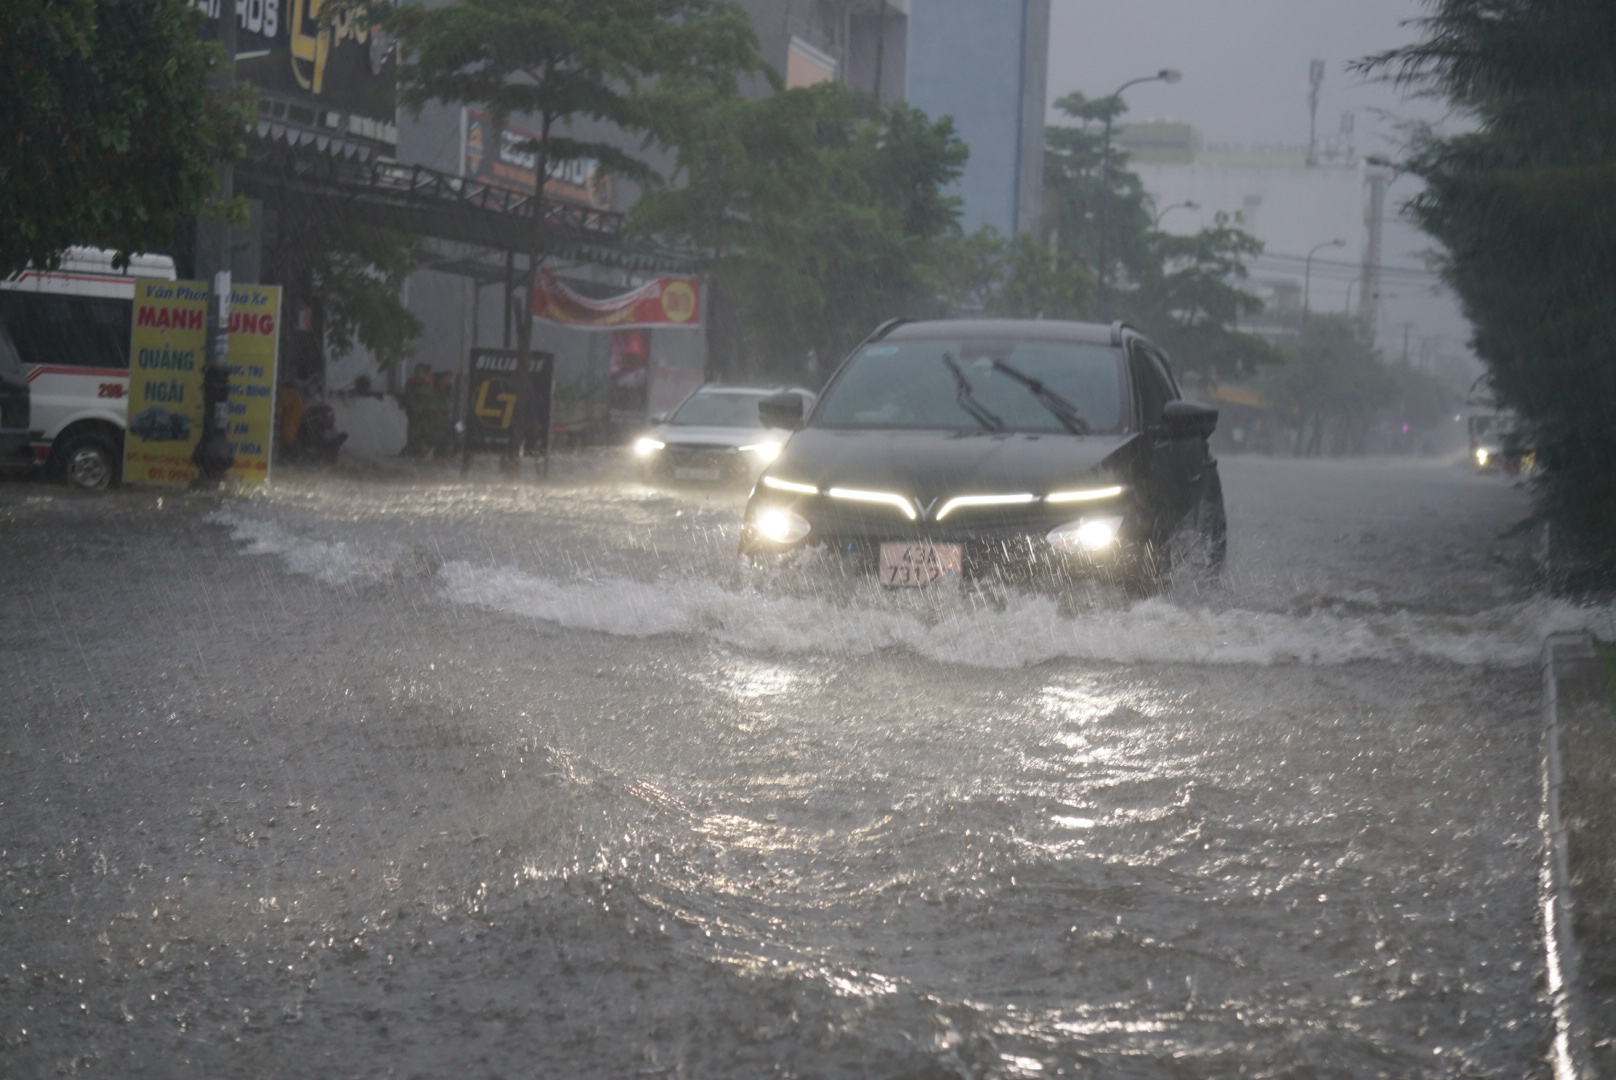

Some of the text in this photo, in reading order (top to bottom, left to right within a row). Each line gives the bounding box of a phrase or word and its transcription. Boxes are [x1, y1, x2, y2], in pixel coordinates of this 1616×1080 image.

[176, 285, 208, 301] Phòn
[251, 291, 268, 306] Xe
[136, 305, 204, 334] MẠNH
[138, 344, 194, 371] QUẢNG
[144, 379, 184, 402] NGÃI
[903, 546, 937, 564] 43A
